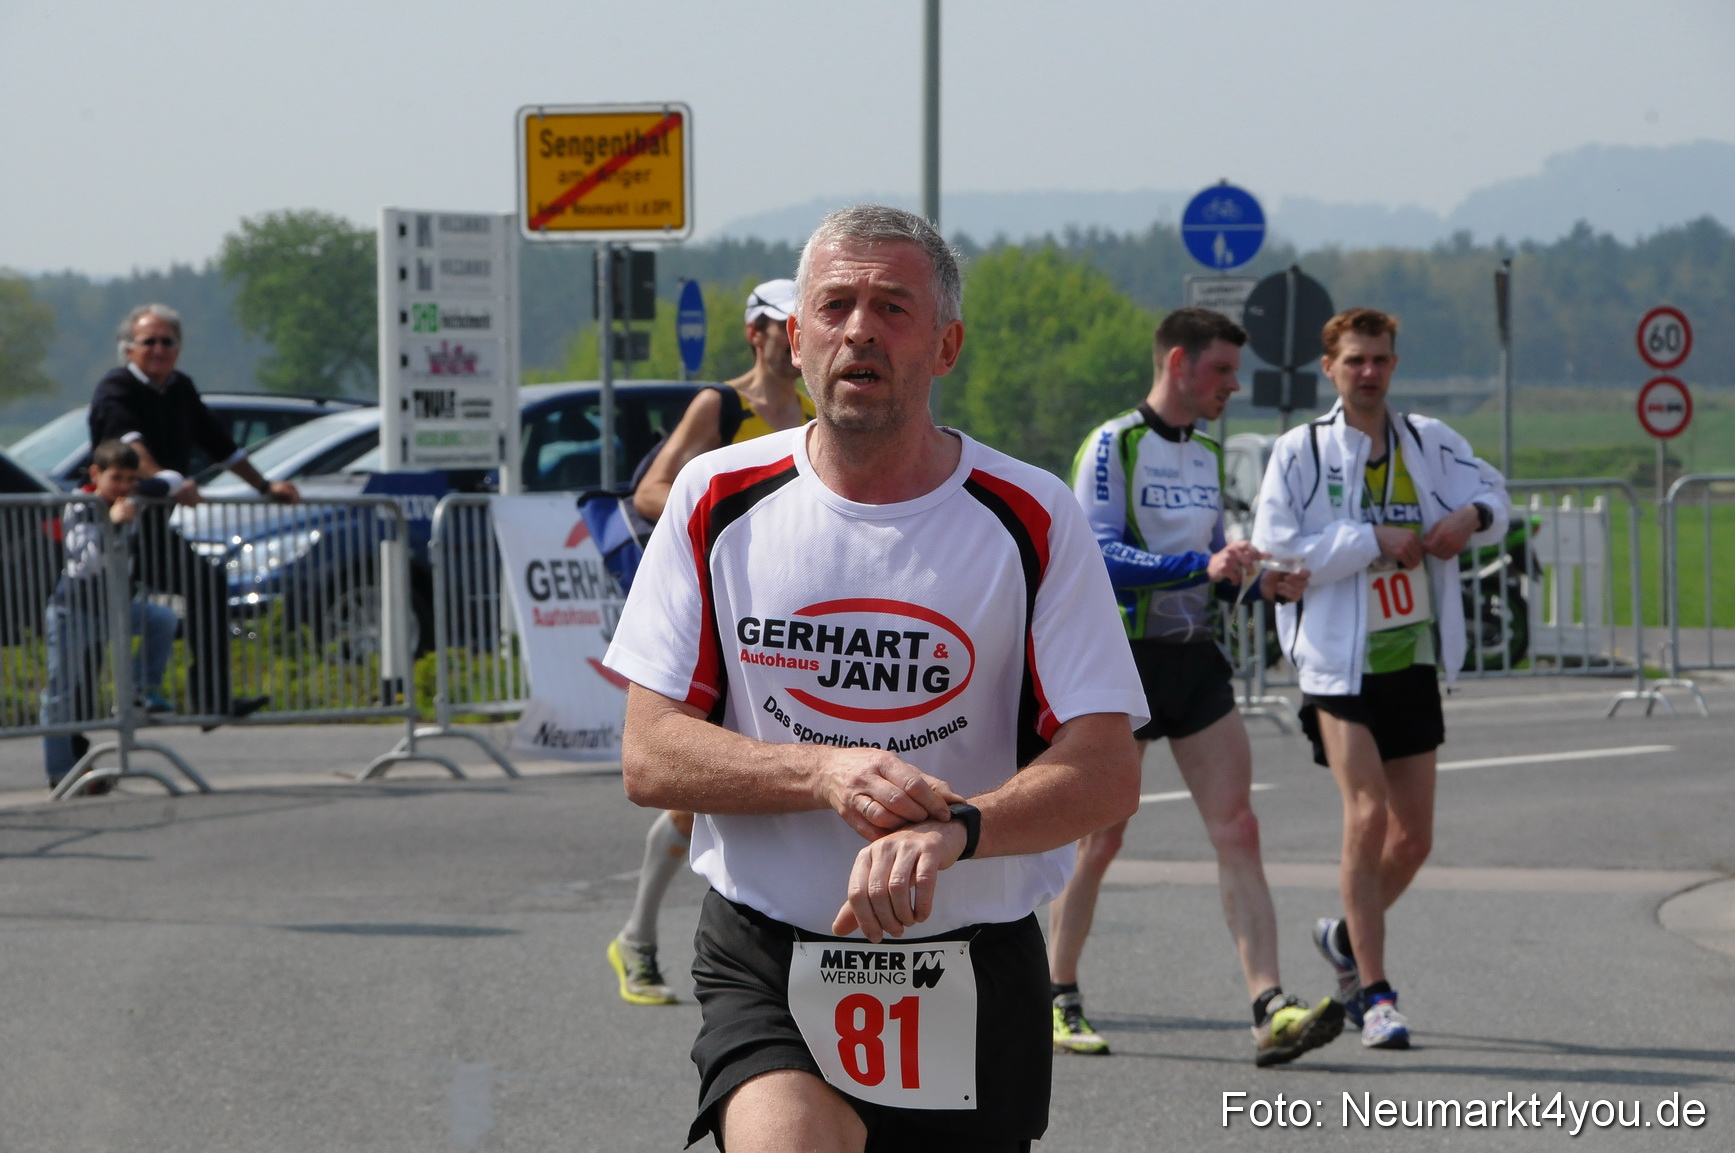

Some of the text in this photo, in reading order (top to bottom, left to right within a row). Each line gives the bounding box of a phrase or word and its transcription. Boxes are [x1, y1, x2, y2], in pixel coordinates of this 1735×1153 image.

[540, 128, 669, 164] Sengenthal
[1648, 323, 1680, 353] 60
[1096, 431, 1113, 501] BOCK
[1140, 483, 1219, 510] BOCK
[1372, 572, 1415, 619] 10
[533, 606, 601, 627] Autohaus
[737, 617, 949, 660] GERHART &
[740, 649, 820, 671] Autohaus
[817, 659, 951, 693] JÄNIG
[763, 696, 792, 728] Das
[886, 715, 968, 753] Autohaus
[820, 950, 906, 971] MEYER
[820, 970, 907, 985] WERBUNG
[834, 992, 921, 1090] 81
